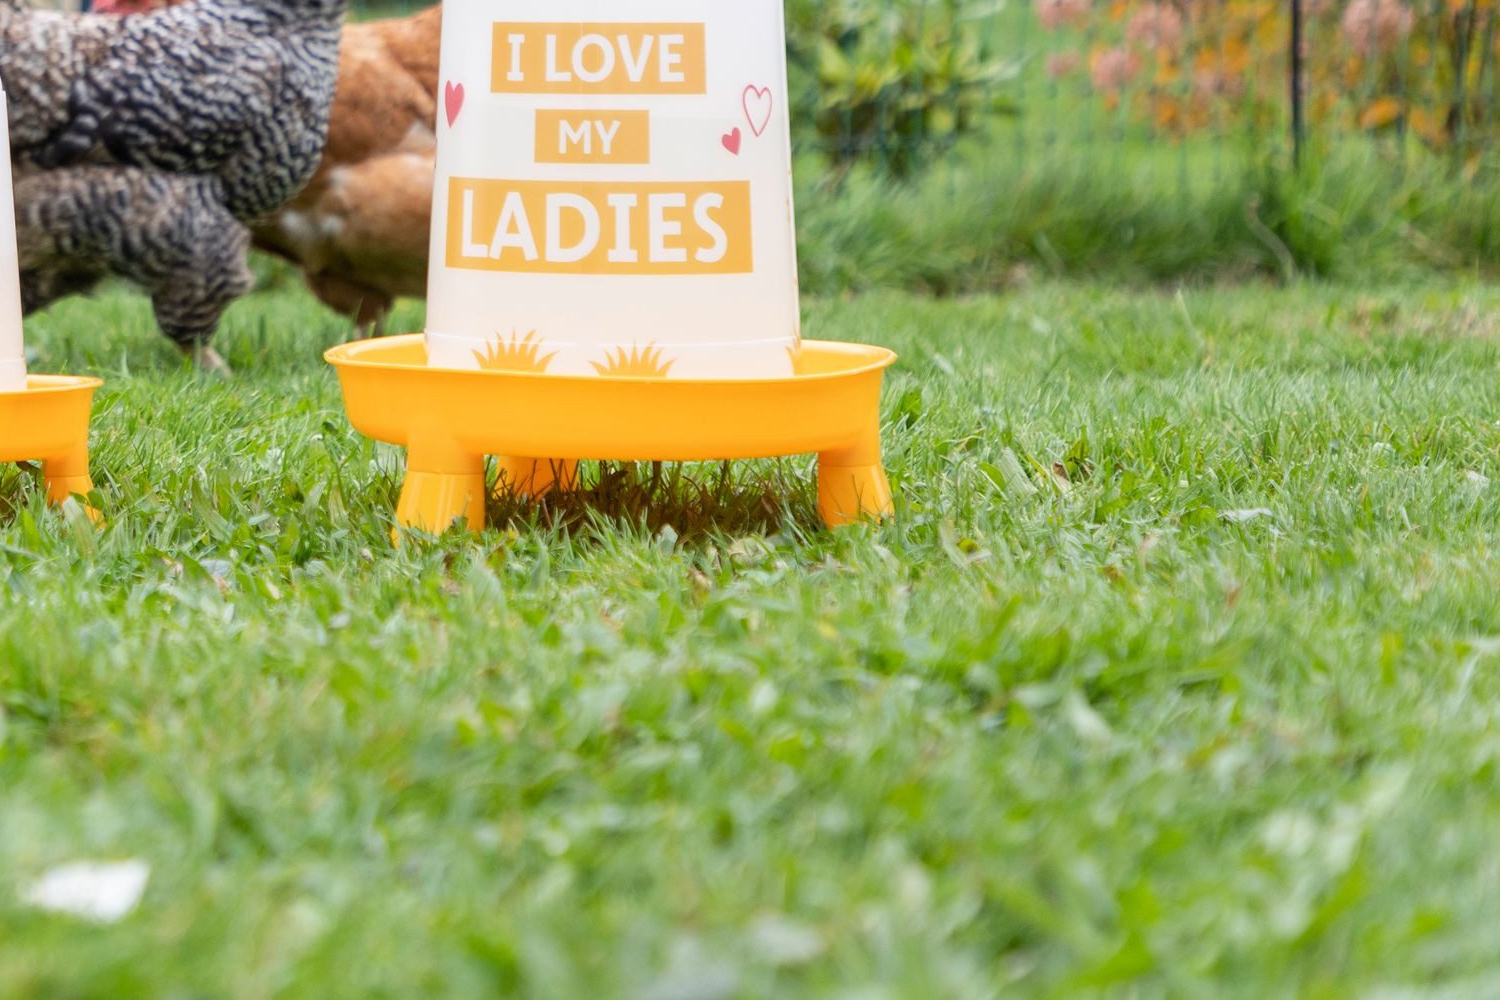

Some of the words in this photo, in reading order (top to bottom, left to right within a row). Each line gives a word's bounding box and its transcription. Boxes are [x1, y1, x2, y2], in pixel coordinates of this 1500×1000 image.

[506, 33, 525, 81] I
[545, 33, 685, 83] LOVE
[557, 119, 621, 155] MY
[460, 188, 728, 264] LADIES
